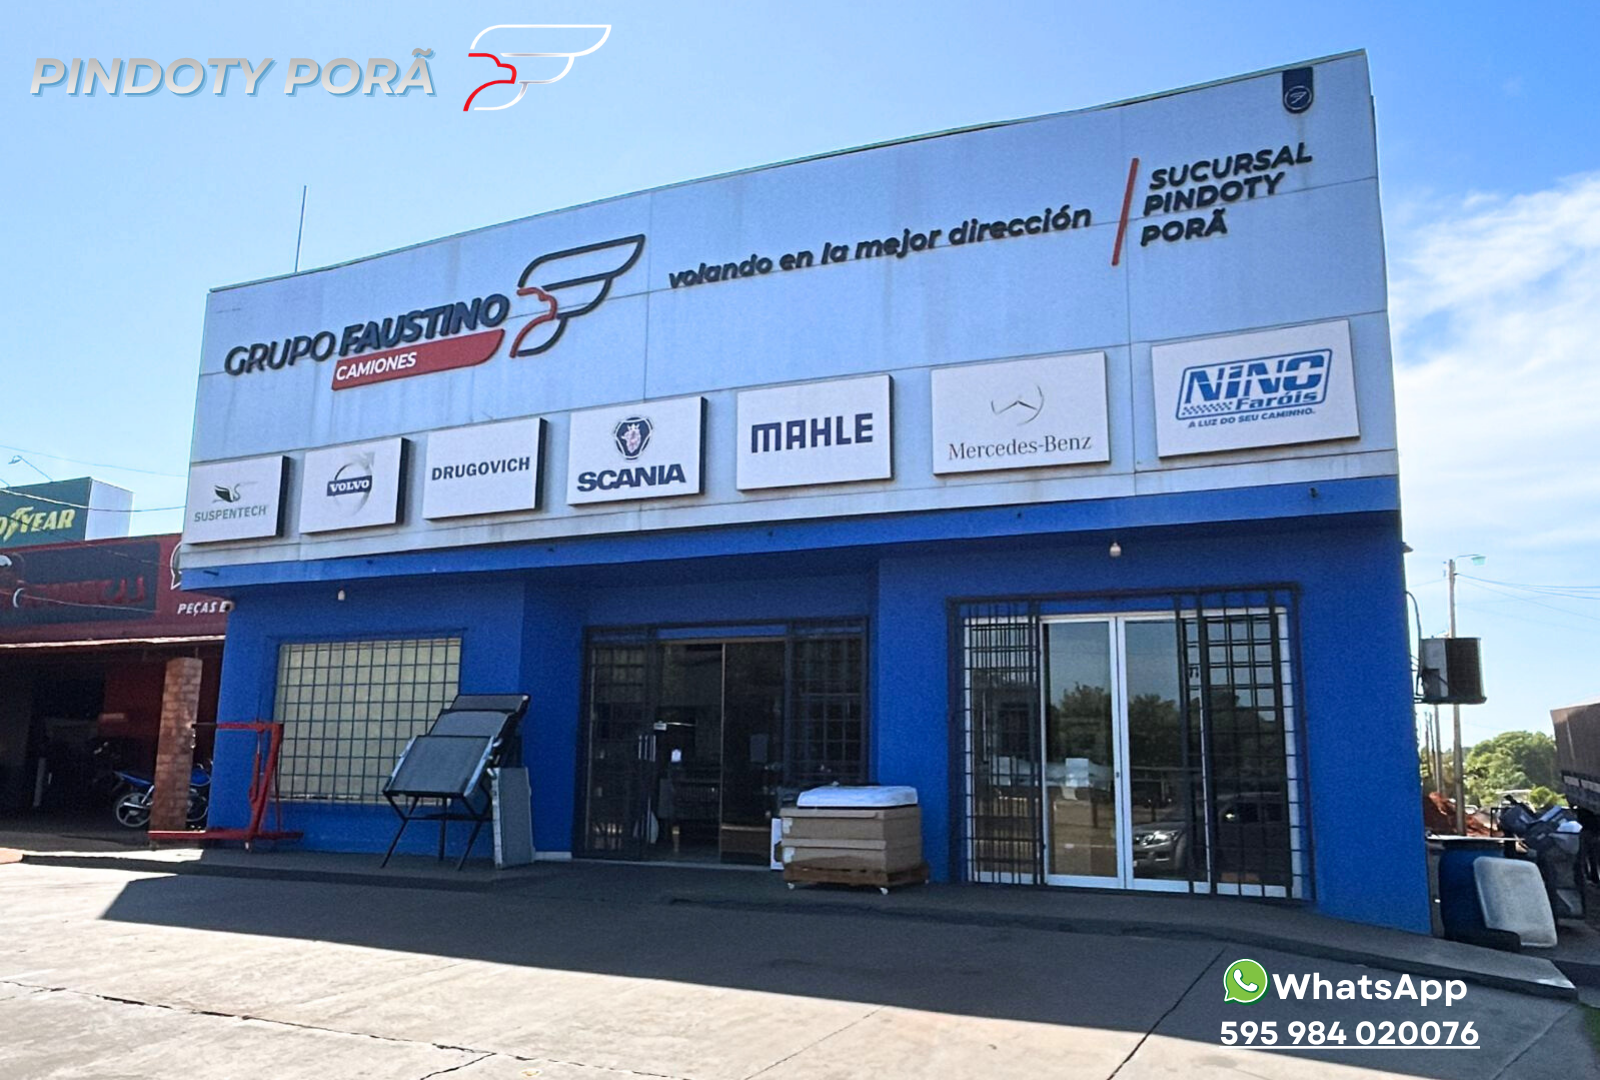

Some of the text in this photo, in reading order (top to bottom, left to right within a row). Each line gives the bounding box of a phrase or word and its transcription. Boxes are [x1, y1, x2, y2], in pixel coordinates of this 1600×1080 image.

[1149, 142, 1313, 191] SUCURSAL
[1143, 171, 1286, 217] PINDOTY
[1140, 208, 1228, 247] PORÃ
[669, 204, 1092, 289] volando en la mejor dirección
[224, 293, 510, 376] GRUPO FAUSTINO
[336, 352, 418, 381] CAMIONES
[1235, 391, 1318, 411] Faróis
[751, 412, 874, 454] MAHLE
[1188, 420, 1196, 429] A
[1198, 419, 1217, 427] LUZ
[1220, 416, 1236, 425] DO
[1238, 413, 1259, 422] SEU
[948, 434, 1093, 461] Mercedes-Benz
[431, 456, 531, 481] DRUGOVICH
[576, 463, 687, 493] SCANIA
[329, 479, 371, 494] VOLVO
[194, 505, 268, 523] SUSPENTECH
[177, 602, 217, 616] PEÇAS
